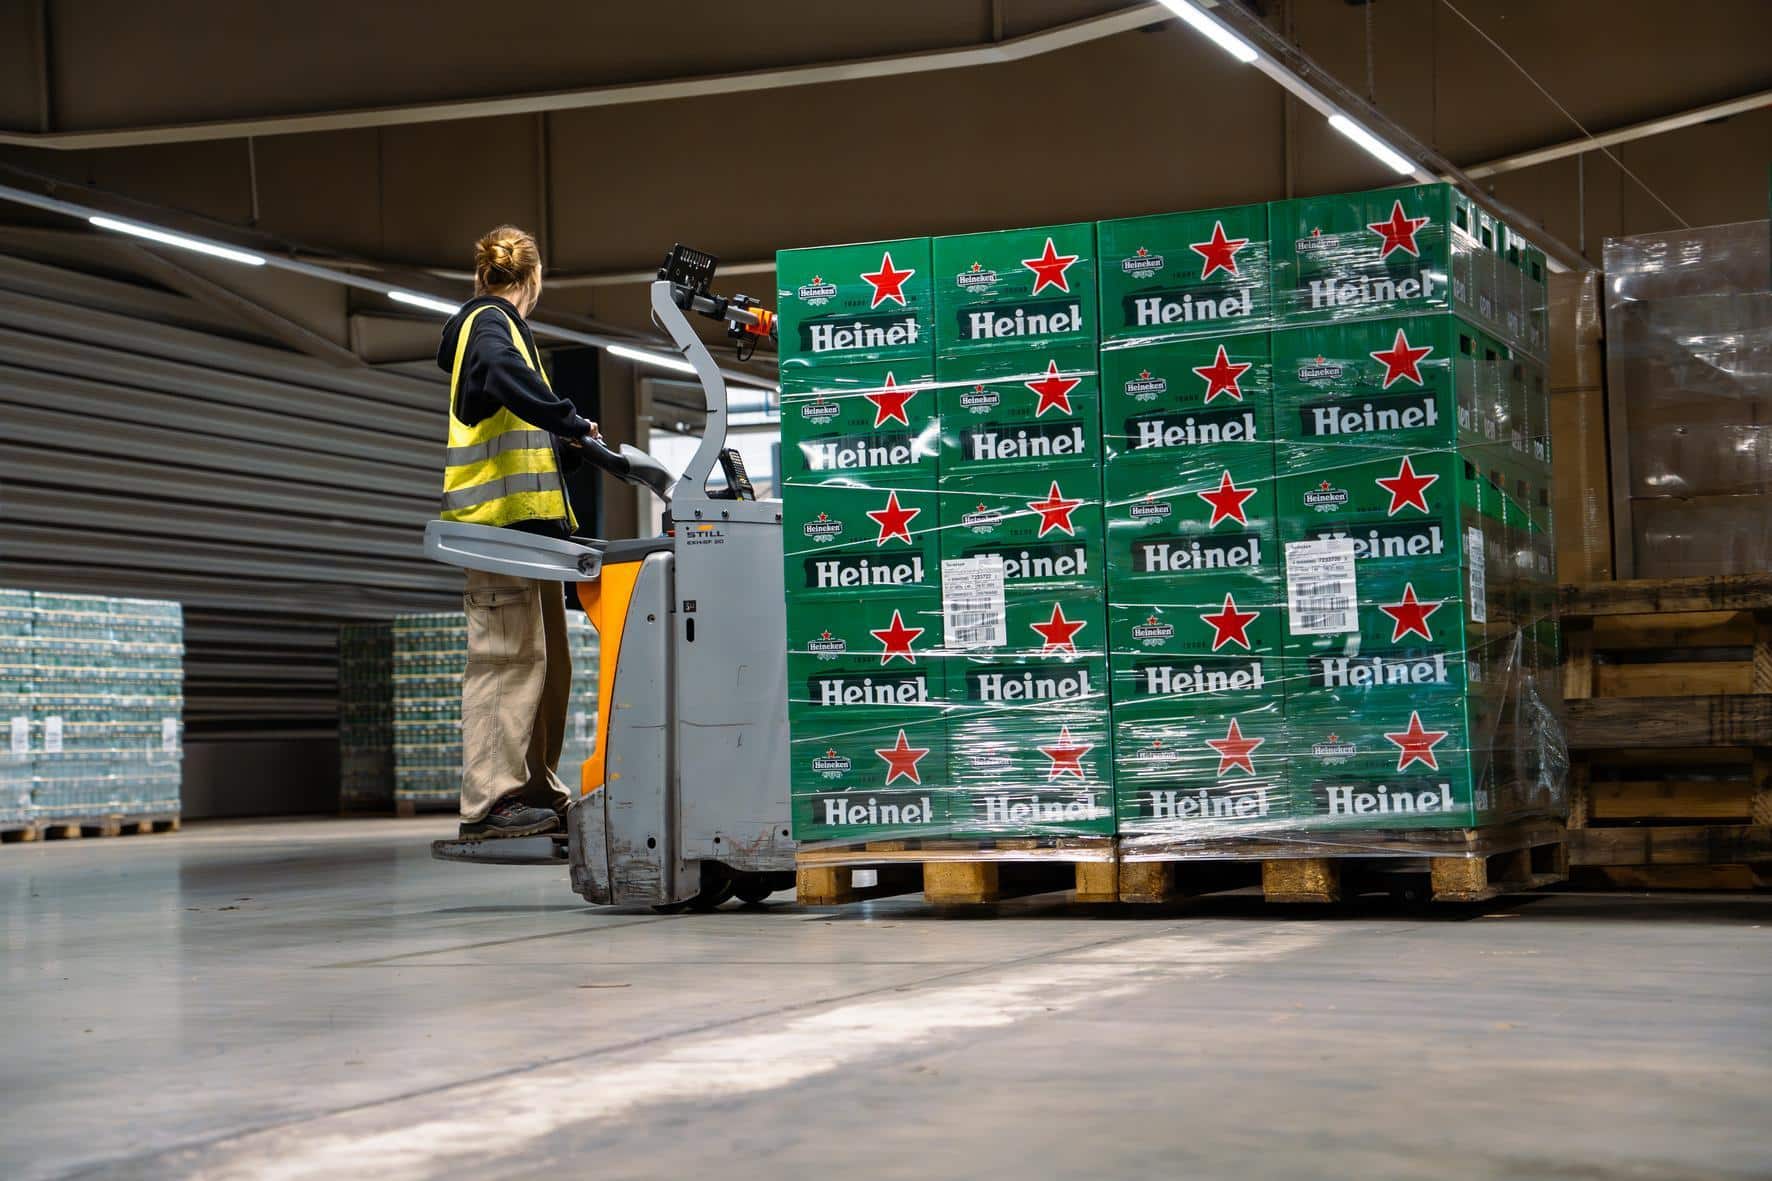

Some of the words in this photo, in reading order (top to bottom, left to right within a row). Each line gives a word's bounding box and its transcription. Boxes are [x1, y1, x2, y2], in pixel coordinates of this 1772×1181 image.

[1124, 258, 1161, 270] Heineken
[960, 273, 995, 284] Heineken
[800, 286, 835, 298] Heineken
[1300, 367, 1340, 379] Heineken
[1127, 382, 1164, 392] Heineken
[962, 395, 998, 405] Heineken
[803, 406, 838, 416] Heineken
[1305, 491, 1346, 504] Heineken
[1132, 505, 1169, 515] Heineken
[687, 530, 725, 538] STILL
[806, 524, 841, 534] Heineken
[1134, 628, 1172, 638] Heineken
[809, 642, 844, 652] Heineken
[815, 760, 849, 769] Heineken
